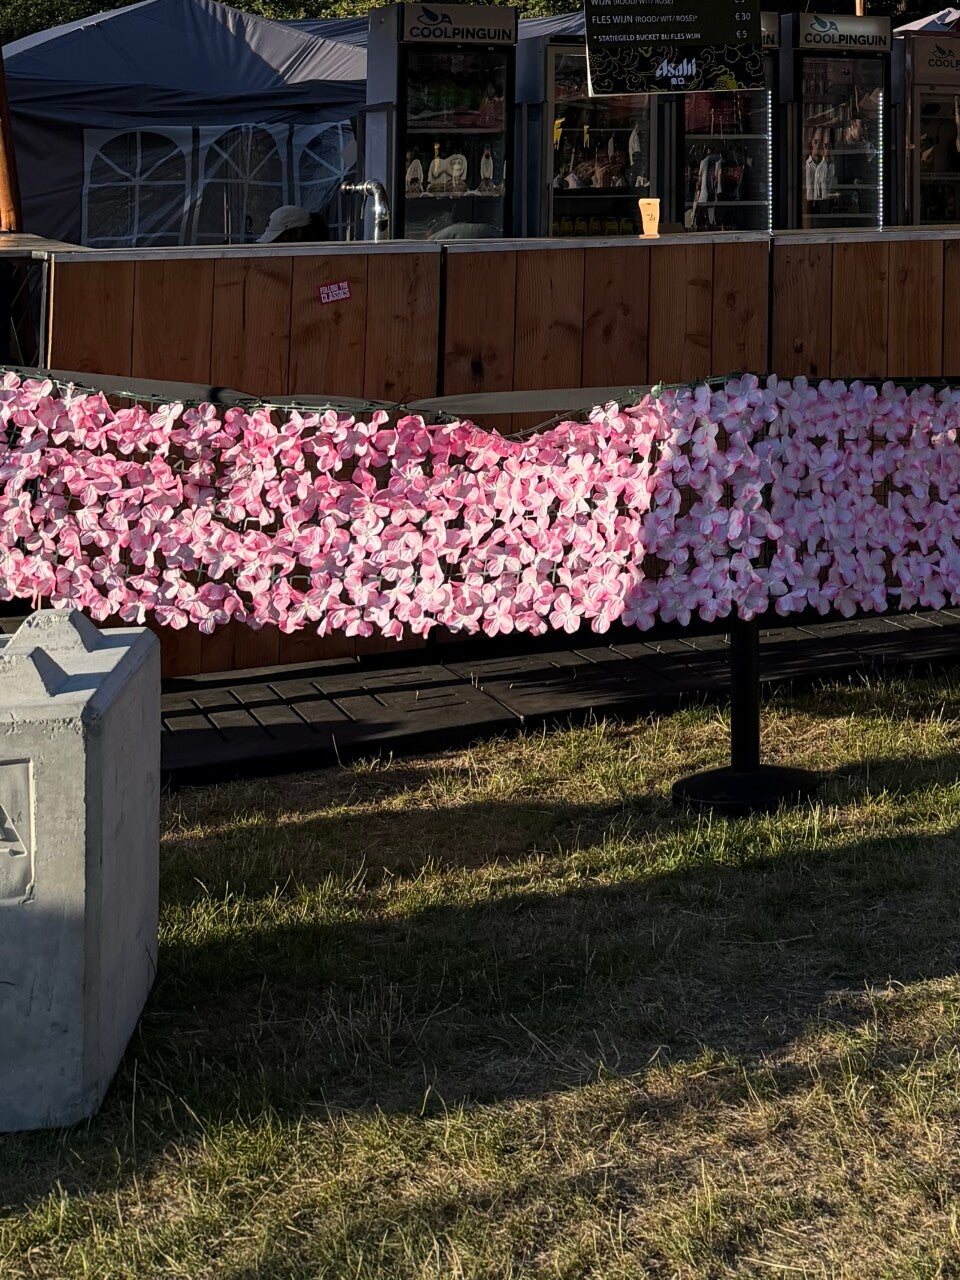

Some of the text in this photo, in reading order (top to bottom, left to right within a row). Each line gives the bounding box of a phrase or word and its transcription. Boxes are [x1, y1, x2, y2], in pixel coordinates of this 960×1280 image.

[410, 26, 512, 40] COOLPINGUIN
[804, 33, 887, 46] COOLPINGUIN
[656, 58, 697, 79] Asahi
